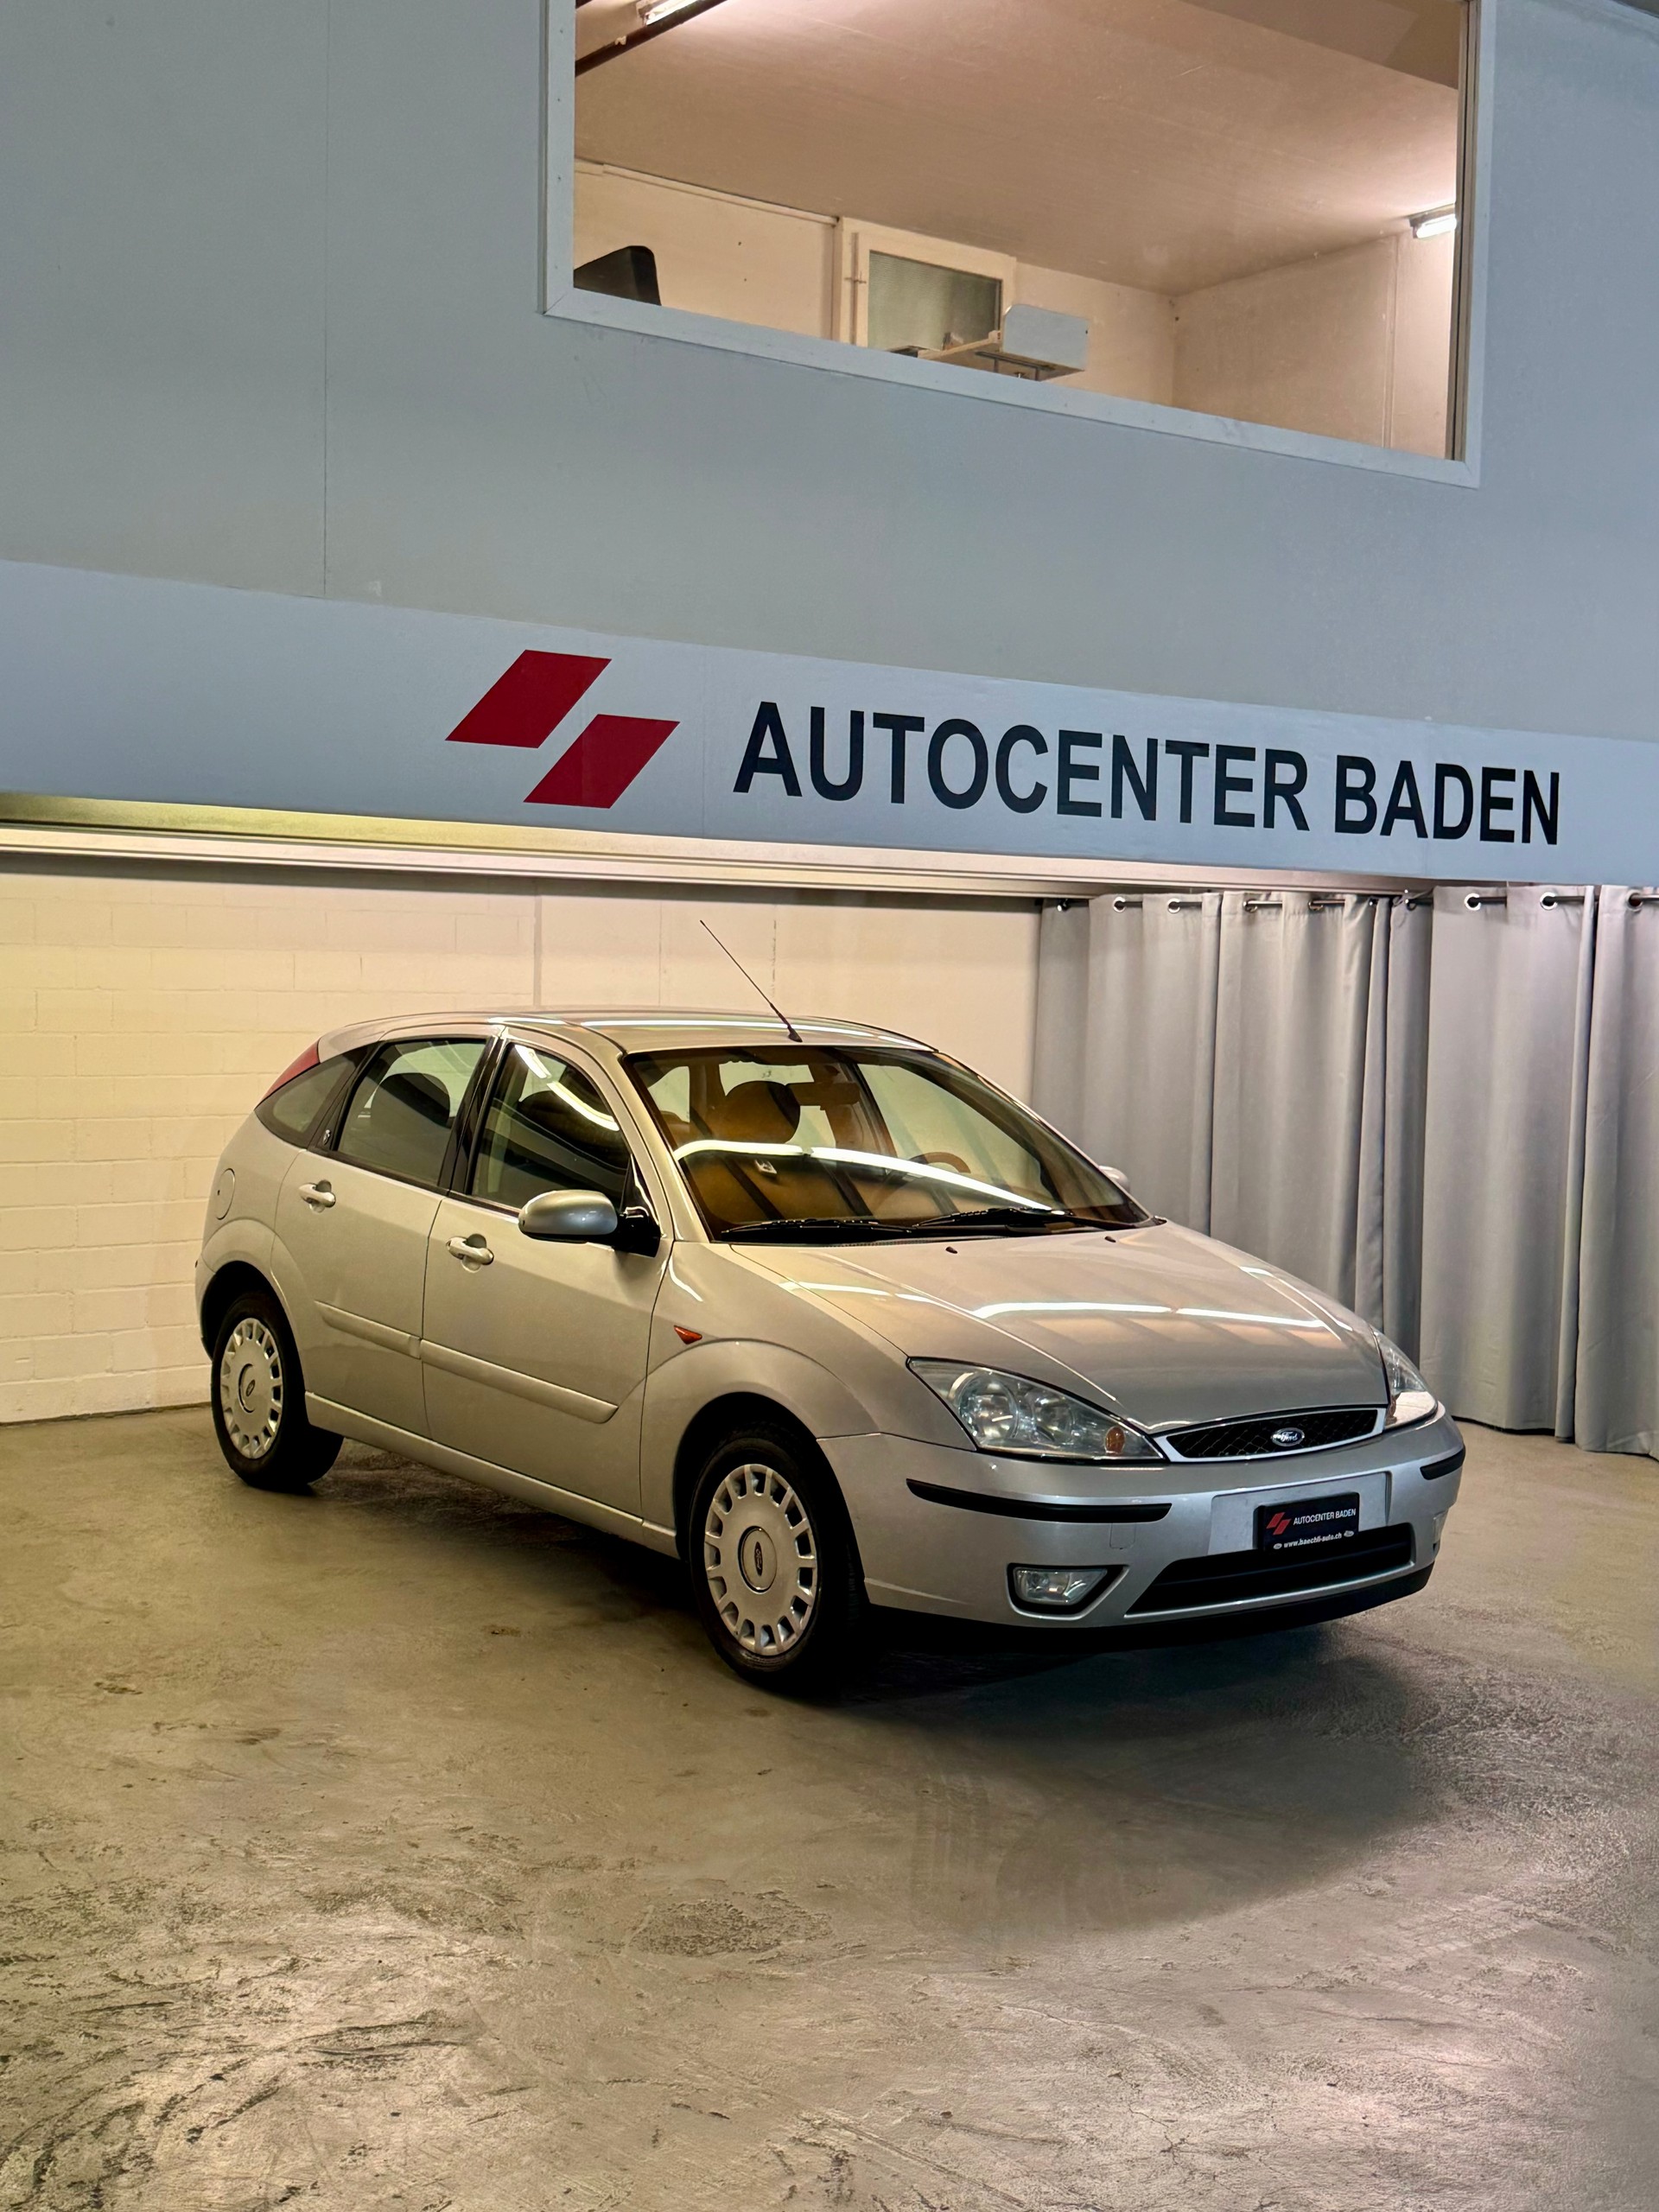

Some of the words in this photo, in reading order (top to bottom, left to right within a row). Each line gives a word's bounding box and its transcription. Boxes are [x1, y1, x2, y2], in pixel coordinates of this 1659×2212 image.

[733, 701, 1310, 831] AUTOCENTER
[1334, 754, 1560, 845] BADEN
[1294, 1512, 1334, 1525] AUTOCENTER
[1335, 1508, 1357, 1518] BADEN
